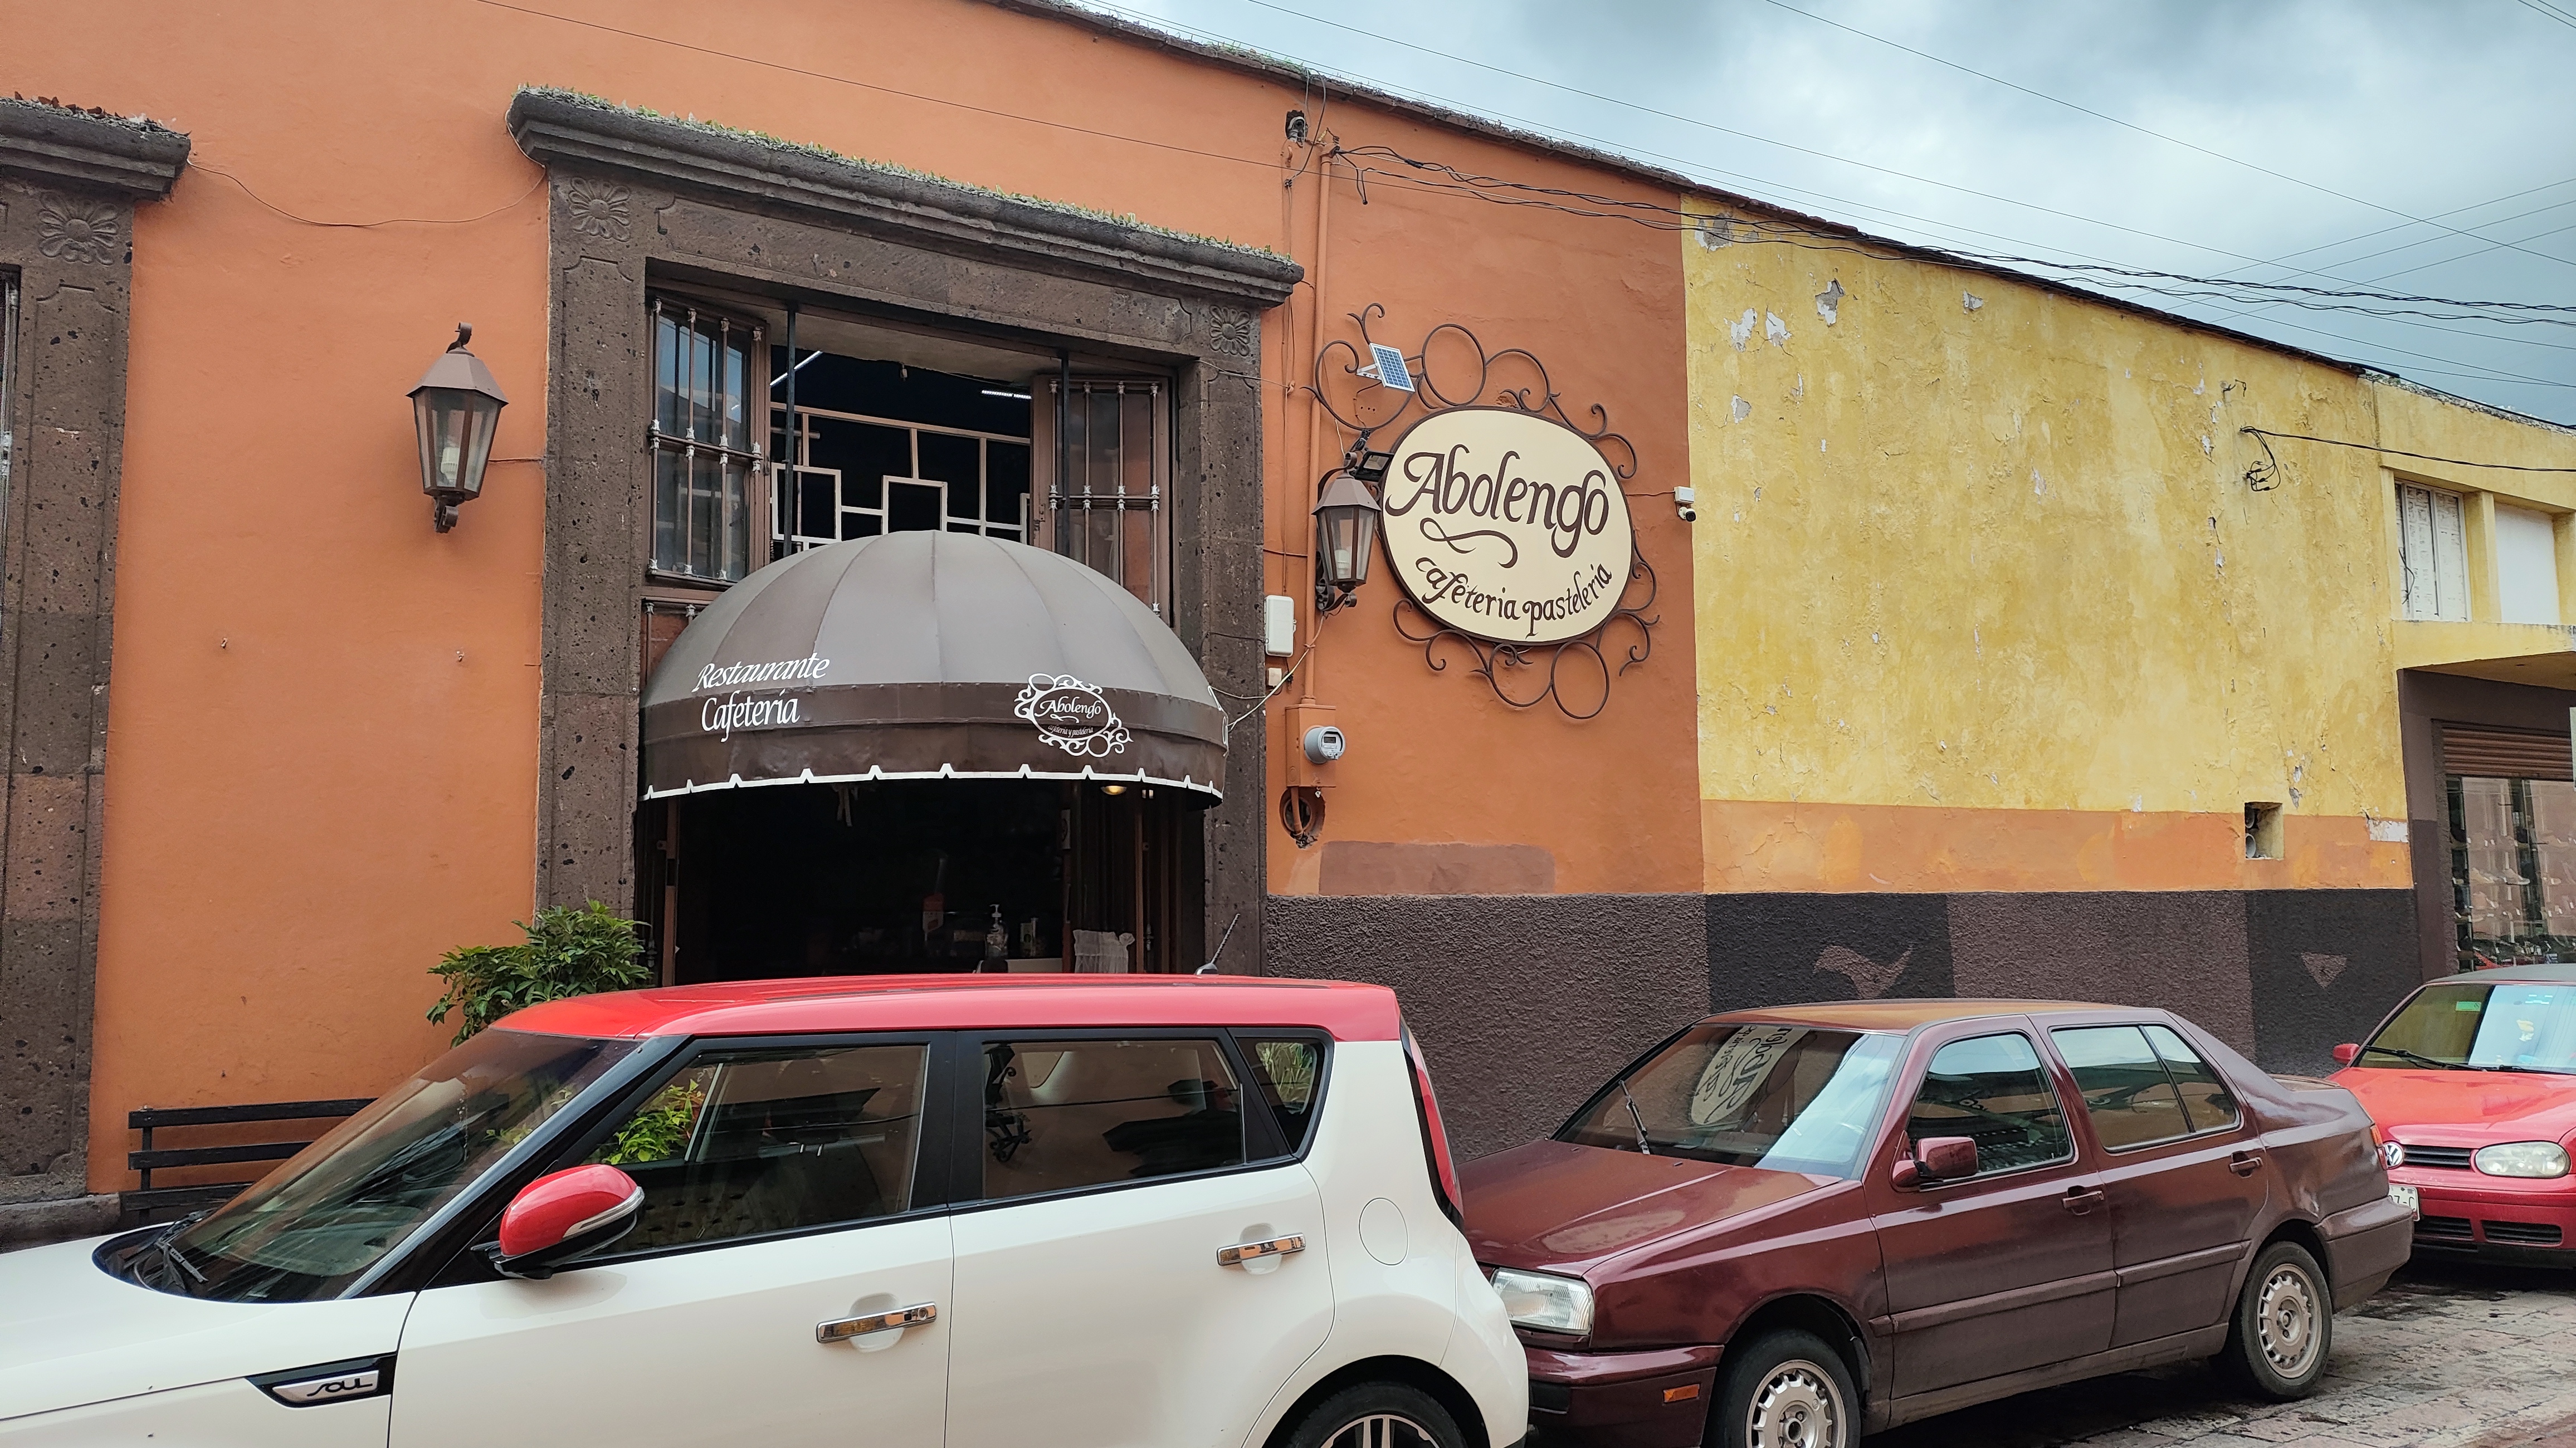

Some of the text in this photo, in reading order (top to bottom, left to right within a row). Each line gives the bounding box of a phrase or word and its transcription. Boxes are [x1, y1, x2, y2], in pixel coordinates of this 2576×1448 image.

[1385, 444, 1609, 558] Abolengo
[1416, 557, 1612, 639] cafeteria pasteleria
[691, 652, 830, 692] Restaurante
[701, 688, 800, 742] Cafetería
[1035, 696, 1101, 718] Abolengo
[1068, 729, 1072, 738] y
